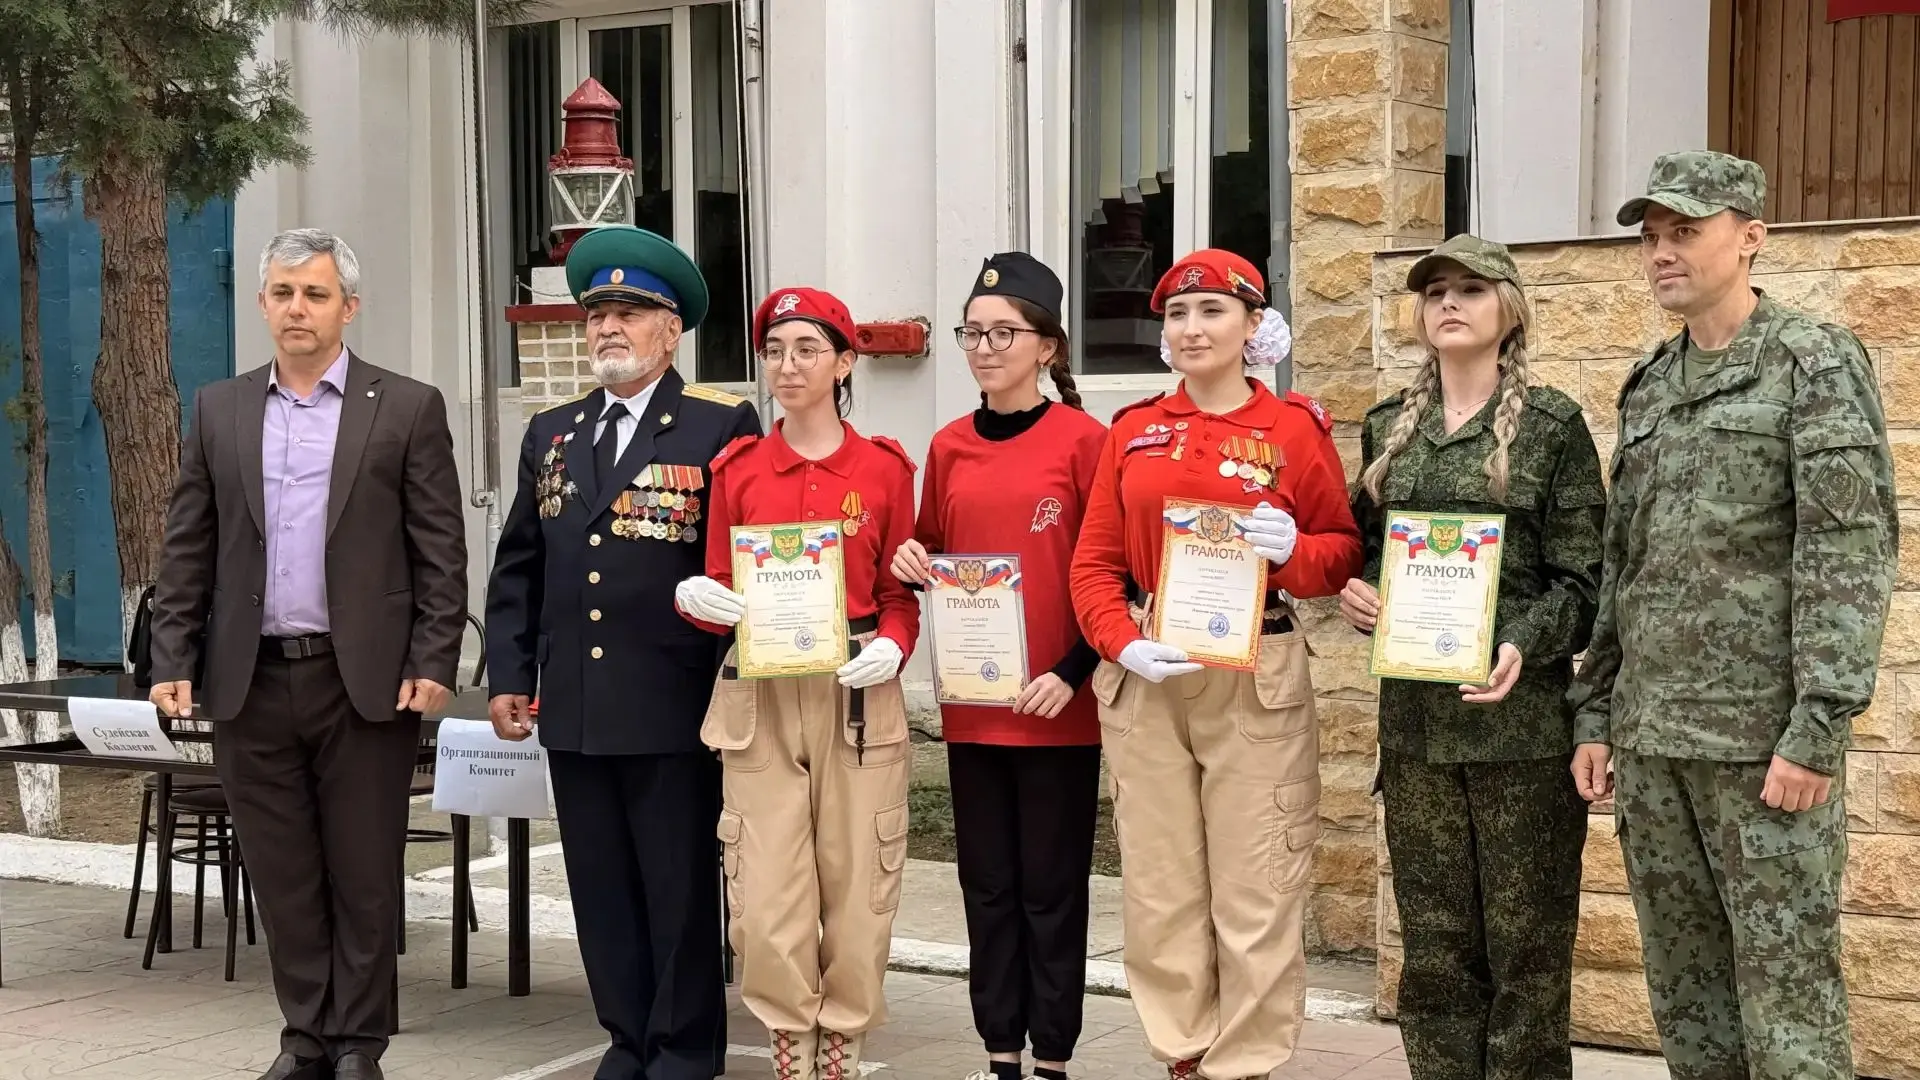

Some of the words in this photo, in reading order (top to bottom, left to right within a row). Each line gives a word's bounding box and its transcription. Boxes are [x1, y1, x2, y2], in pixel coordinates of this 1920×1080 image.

[1185, 544, 1244, 561] ГРАМОТА
[756, 569, 823, 583] ГРАМОТА
[1406, 564, 1475, 579] ГРАМОТА
[946, 597, 1000, 609] ГРАМОТА
[92, 726, 150, 740] Судейская
[103, 741, 158, 752] Коллегия
[440, 745, 540, 760] Организационный
[469, 764, 516, 777] Комитет
